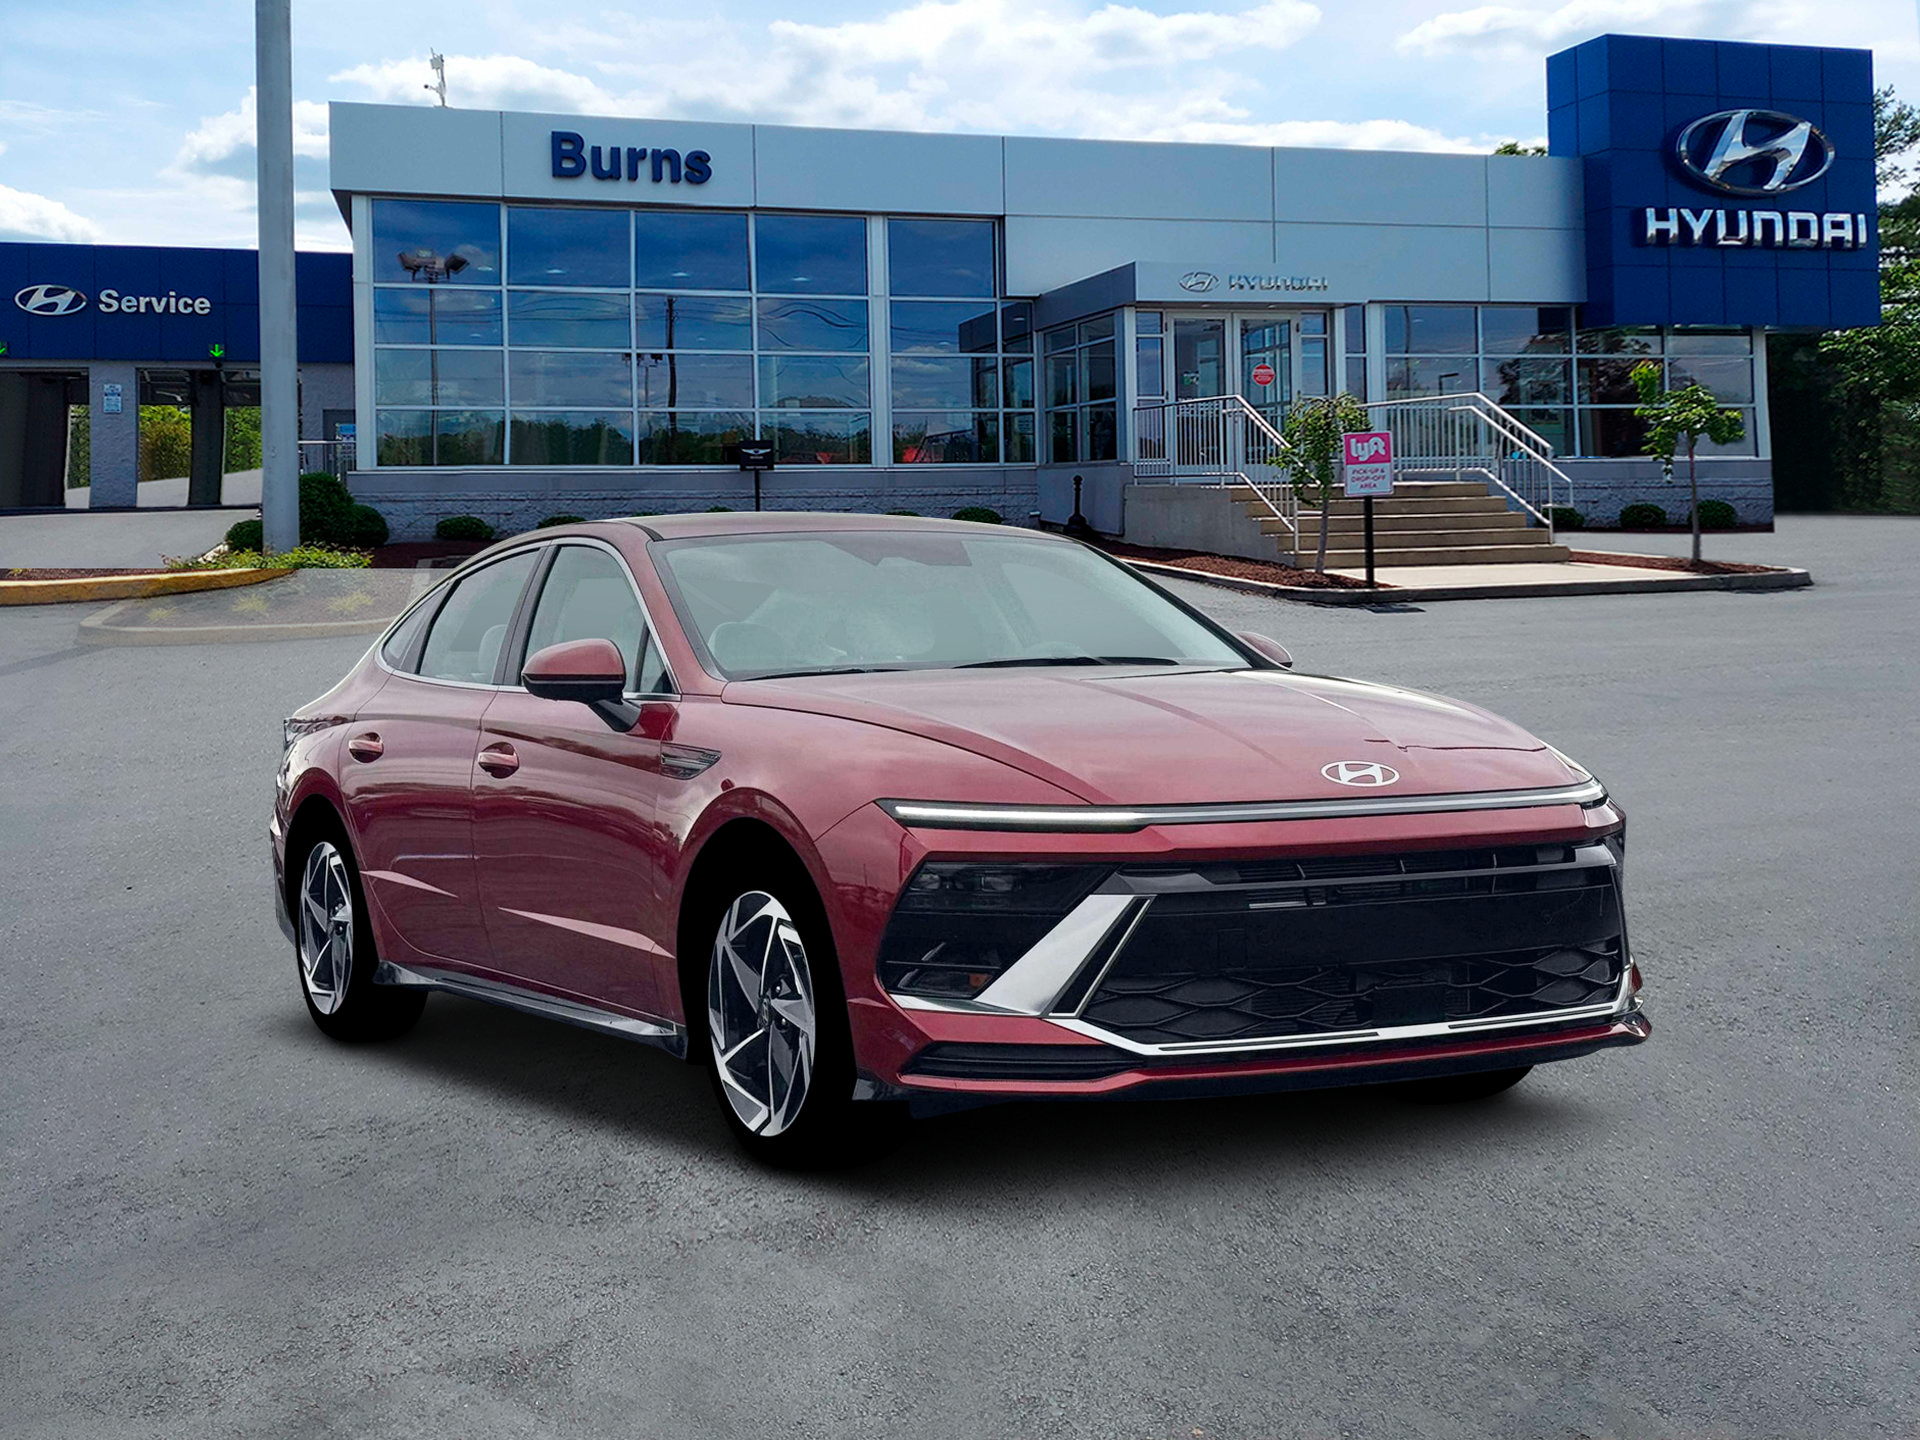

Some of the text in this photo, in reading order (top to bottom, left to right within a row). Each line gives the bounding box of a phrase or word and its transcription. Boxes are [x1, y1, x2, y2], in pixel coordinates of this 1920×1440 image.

[551, 130, 712, 184] Burns
[1645, 207, 1868, 248] HYUNDAI
[1228, 274, 1329, 291] HYUNDAI
[99, 289, 212, 315] Service
